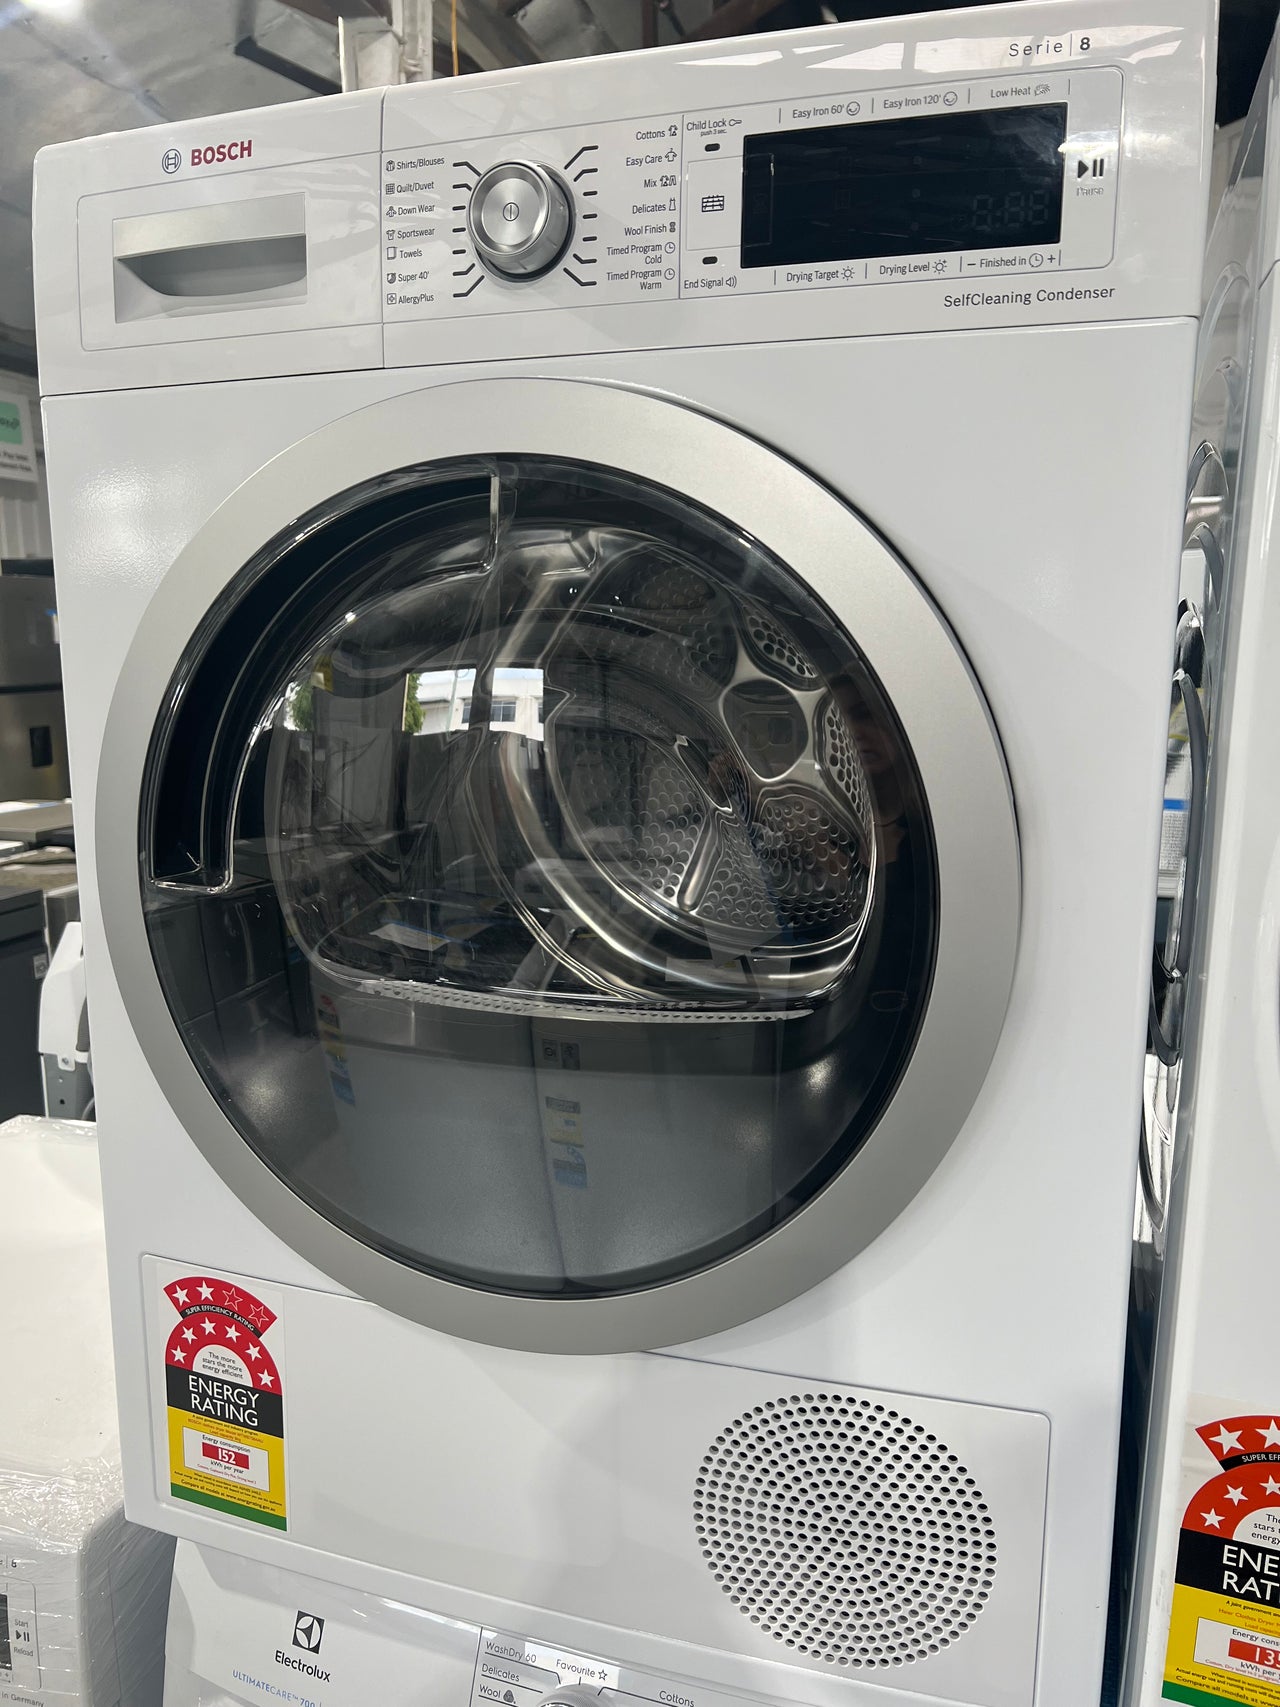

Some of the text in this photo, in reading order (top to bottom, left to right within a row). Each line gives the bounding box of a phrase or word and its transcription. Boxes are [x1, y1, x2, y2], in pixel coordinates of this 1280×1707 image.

[1009, 37, 1090, 56] Serie 8
[990, 86, 1031, 99] Low Heat
[883, 99, 903, 110] Easy
[904, 96, 922, 108] Iron
[792, 108, 812, 120] Easy
[813, 106, 830, 117] Iron
[687, 119, 727, 131] Child Lock
[636, 130, 665, 140] Cottons
[191, 139, 252, 166] BOSCH
[396, 157, 445, 170] Shirts/Blouses
[626, 155, 663, 167] Easy Care
[397, 181, 435, 193] Quilt/Duvet
[644, 179, 657, 188] Mix
[398, 204, 435, 216] Down Wear
[632, 204, 666, 215] Delicates
[397, 228, 435, 241] Sportswear
[624, 223, 667, 236] Wool Finish
[400, 249, 423, 259] Towels
[607, 243, 662, 256] Timed Program
[645, 255, 662, 264] Cold
[980, 256, 1027, 269] Finished in
[607, 269, 662, 281] Timed Program
[879, 261, 930, 276] Drying Level
[398, 272, 418, 283] Super
[786, 269, 839, 283] Drying Target
[640, 281, 662, 290] Warm
[684, 277, 724, 289] End Signal
[398, 294, 435, 305] AllergyPlus
[943, 286, 1116, 308] SelfCleaning Condenser
[185, 1305, 255, 1331] SUPER EFFICIENCY RATING
[209, 1351, 236, 1365] The more
[202, 1357, 243, 1373] stars the more
[202, 1364, 244, 1379] energy efficient
[188, 1375, 259, 1408] ENERGY
[191, 1393, 258, 1427] RATING
[202, 1434, 219, 1445] Energy
[219, 1440, 251, 1453] consumption
[218, 1447, 237, 1465] 152
[1241, 1453, 1267, 1463] SUPER
[210, 1459, 223, 1468] kWh
[223, 1464, 232, 1472] per
[1253, 1522, 1275, 1533] stars
[1222, 1544, 1280, 1577] ENE
[1222, 1570, 1280, 1601] RAT
[14, 1618, 29, 1629] Start
[1232, 1628, 1280, 1647] Energy cons
[13, 1646, 34, 1657] Reload
[486, 1641, 537, 1663] WashDry 60
[275, 1649, 331, 1683] Electrolux
[481, 1663, 520, 1682] Delicates
[556, 1658, 596, 1678] Favourite
[1240, 1661, 1260, 1673] kWh
[1262, 1669, 1277, 1677] per
[479, 1684, 501, 1699] Wool
[1175, 1675, 1210, 1689] Compare
[1221, 1688, 1249, 1701] models
[10, 1694, 45, 1707] Germany
[658, 1690, 695, 1707] Cottons
